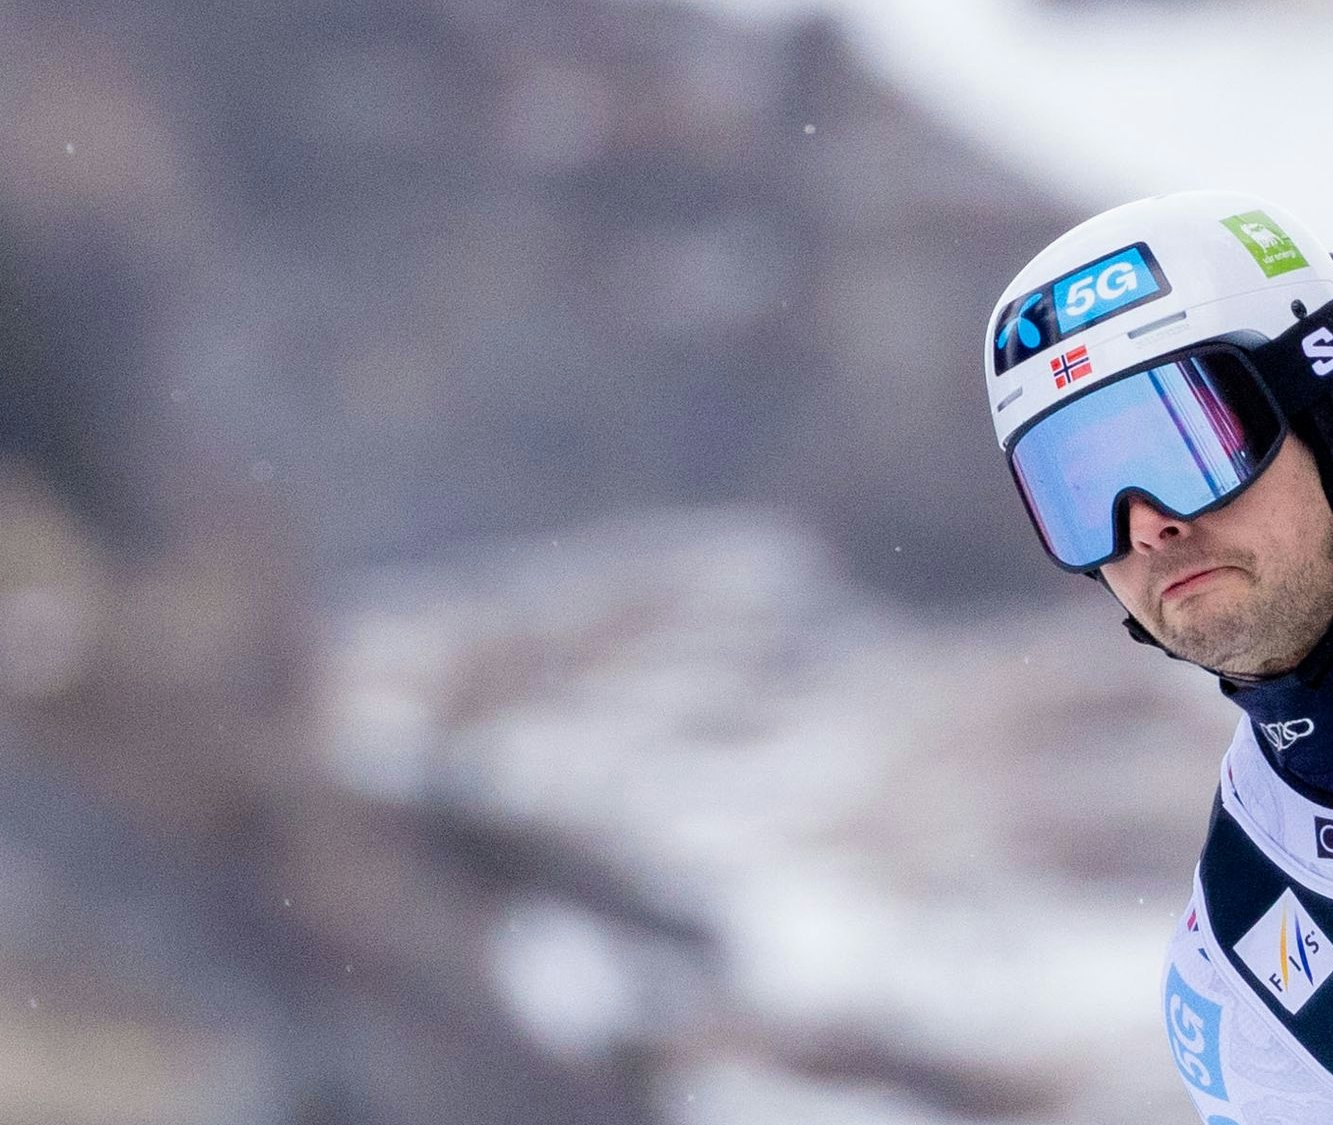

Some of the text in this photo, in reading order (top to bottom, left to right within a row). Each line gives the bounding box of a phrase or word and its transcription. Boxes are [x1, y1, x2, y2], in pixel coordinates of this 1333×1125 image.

[1066, 261, 1139, 317] 5G
[1269, 936, 1320, 992] FIS
[1170, 995, 1211, 1089] 5G
